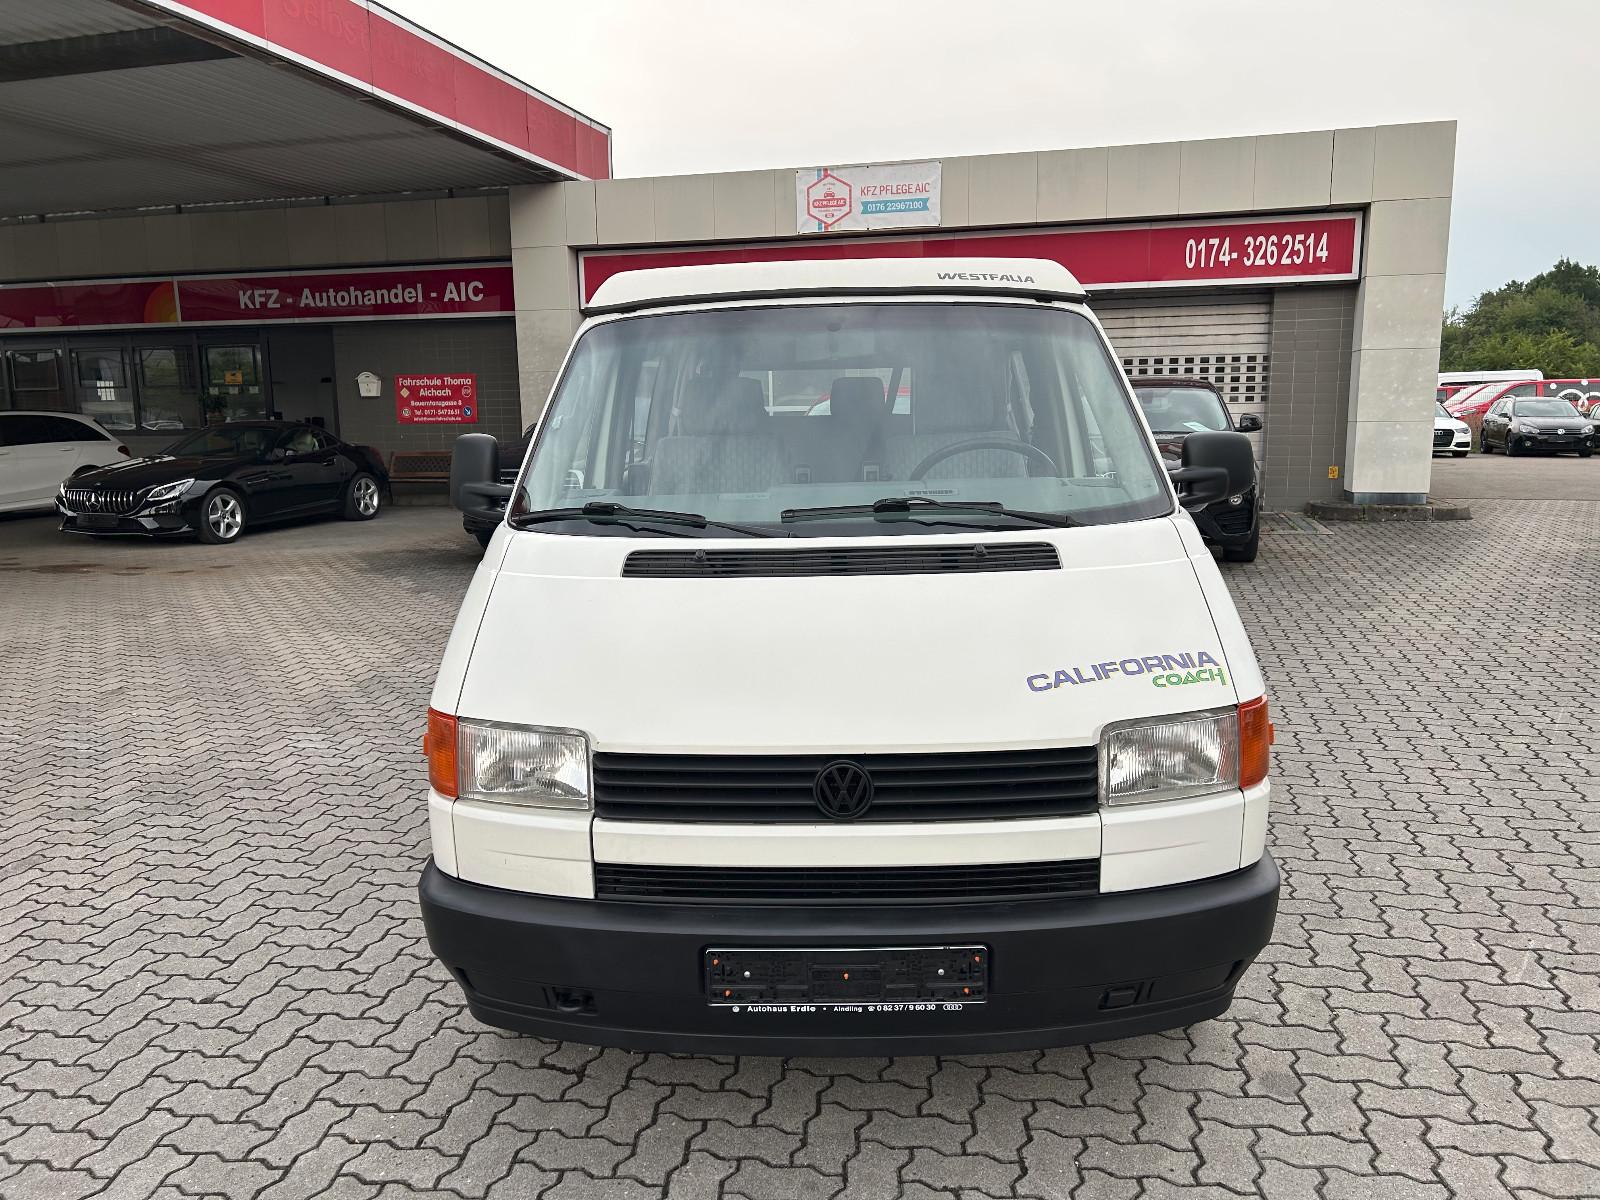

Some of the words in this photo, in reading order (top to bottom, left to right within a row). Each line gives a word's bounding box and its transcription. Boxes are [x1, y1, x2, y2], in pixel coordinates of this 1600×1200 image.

[860, 186, 877, 197] KFZ
[879, 184, 913, 196] PFLEGE
[914, 182, 930, 194] AIC
[867, 203, 885, 212] 0176
[886, 201, 923, 211] 22967100
[1185, 237, 1238, 269] 0174-
[936, 272, 1035, 284] WESTFALIA
[238, 289, 280, 309] KFZ
[299, 283, 423, 308] Autohandel
[443, 281, 484, 302] AIC
[399, 377, 442, 386] Fahrschule
[444, 377, 472, 385] Thoma
[420, 387, 452, 396] Aichach
[1026, 651, 1220, 692] CALIFORNIA
[1152, 667, 1226, 688] COACH
[790, 1005, 816, 1013] Erdle
